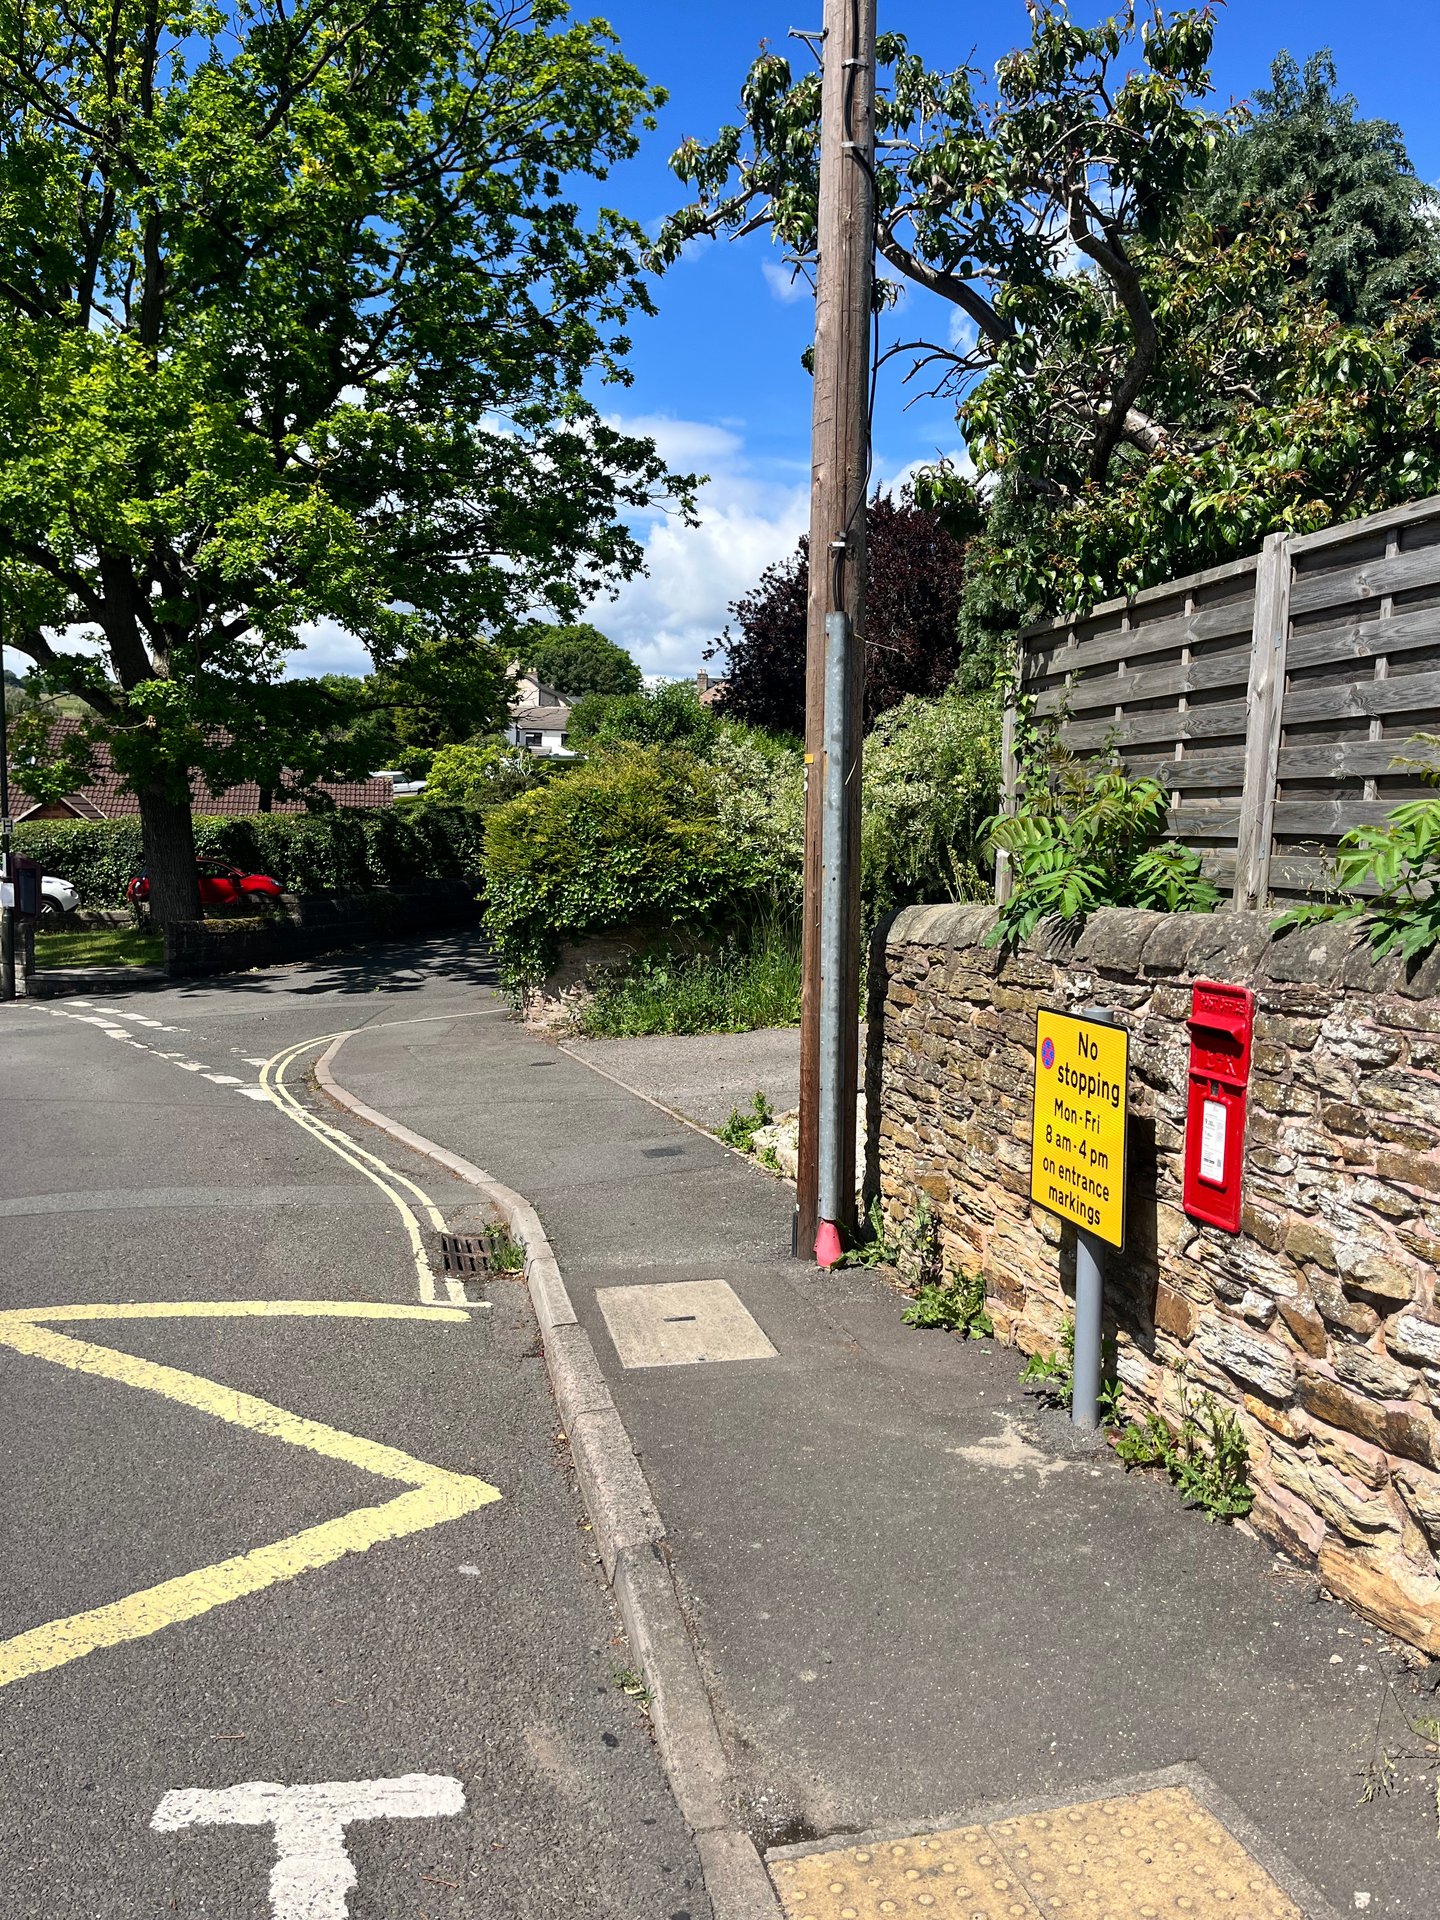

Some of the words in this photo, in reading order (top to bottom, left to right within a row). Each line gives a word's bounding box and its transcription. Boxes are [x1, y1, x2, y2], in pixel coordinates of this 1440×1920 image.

[1078, 1031, 1098, 1061] No
[1057, 1062, 1120, 1109] stopping
[1042, 1157, 1056, 1175] on
[1058, 1164, 1110, 1202] entrance
[1048, 1185, 1101, 1226] markings
